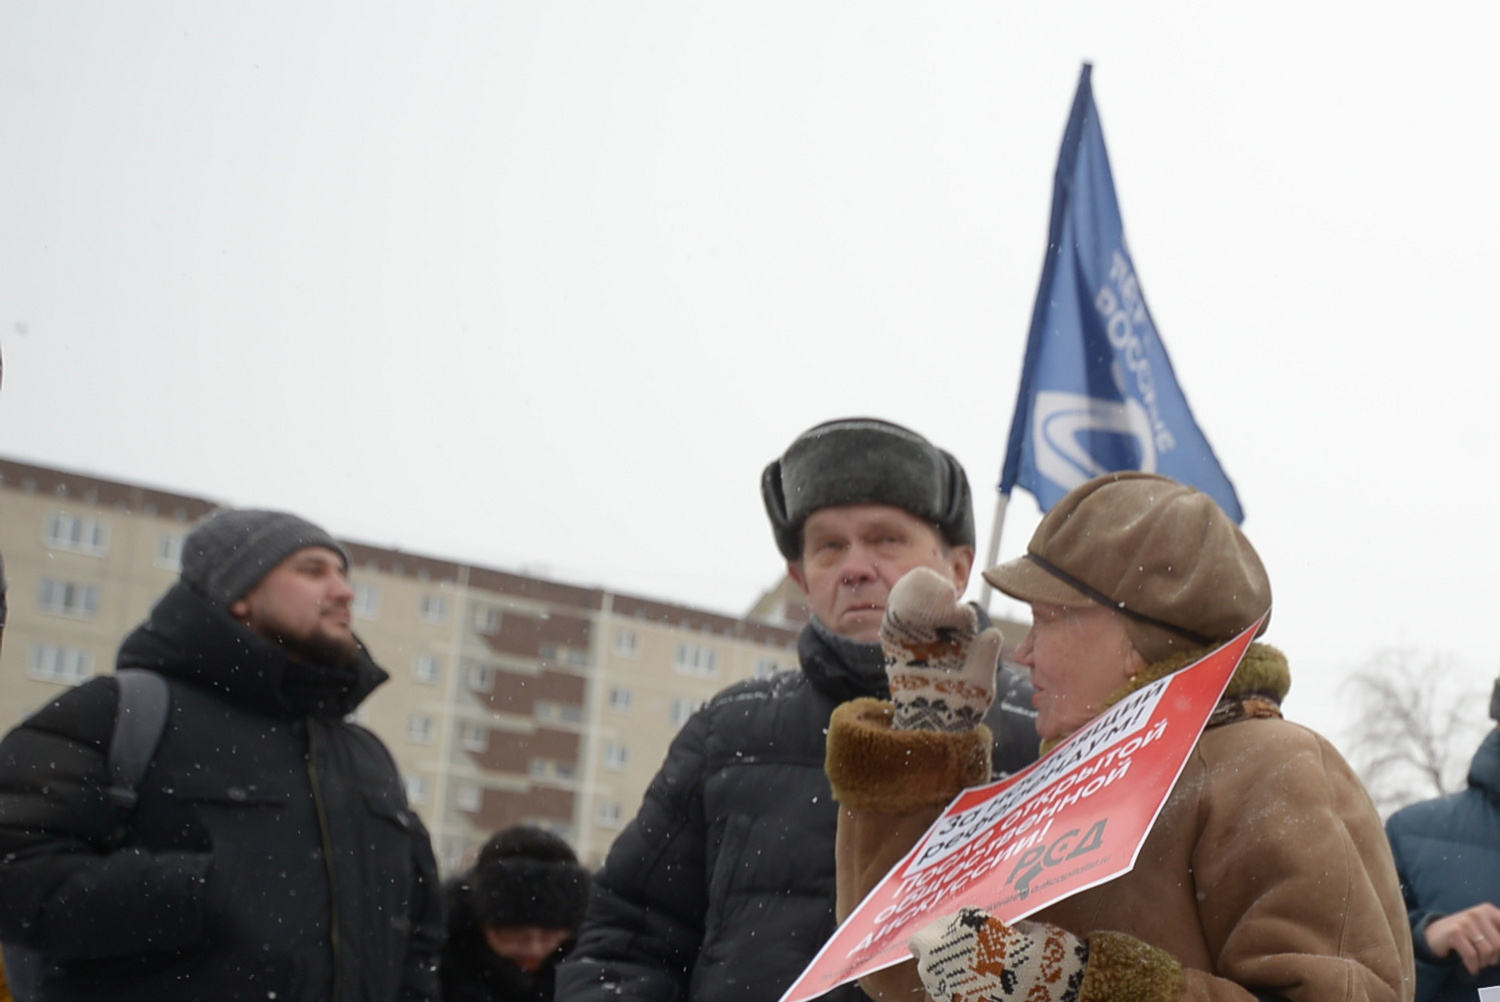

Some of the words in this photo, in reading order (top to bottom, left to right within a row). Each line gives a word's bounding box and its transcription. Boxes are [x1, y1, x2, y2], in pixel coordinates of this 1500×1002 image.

[873, 757, 1132, 924] общественной
[892, 828, 995, 899] После
[1001, 717, 1168, 833] открытой
[939, 807, 982, 837] За
